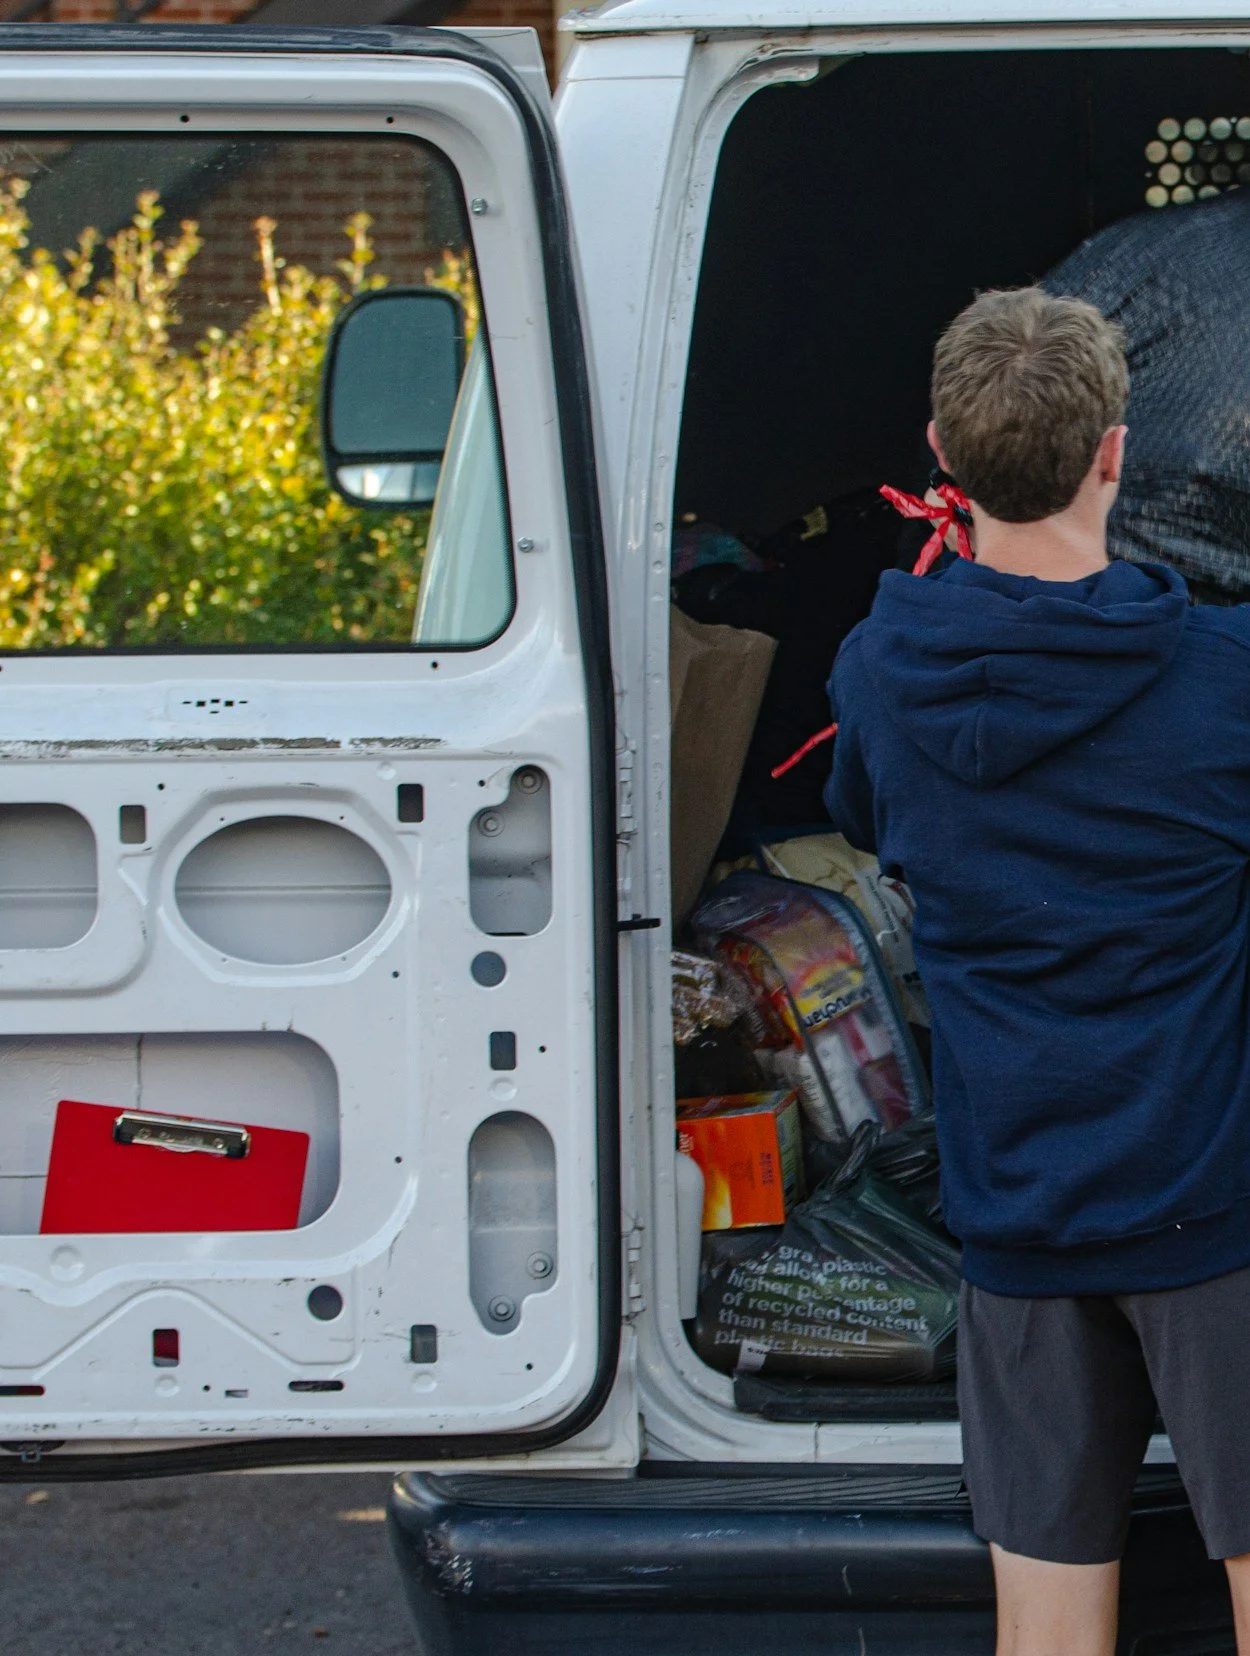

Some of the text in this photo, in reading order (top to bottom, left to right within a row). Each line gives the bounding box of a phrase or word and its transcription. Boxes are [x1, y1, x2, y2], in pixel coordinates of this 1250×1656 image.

[822, 1259, 888, 1276] plastic
[727, 1268, 792, 1296] higher
[840, 1275, 871, 1292] for
[875, 1280, 889, 1292] a
[722, 1292, 746, 1308] of
[748, 1296, 841, 1320] recycled
[718, 1308, 868, 1345] than standard
